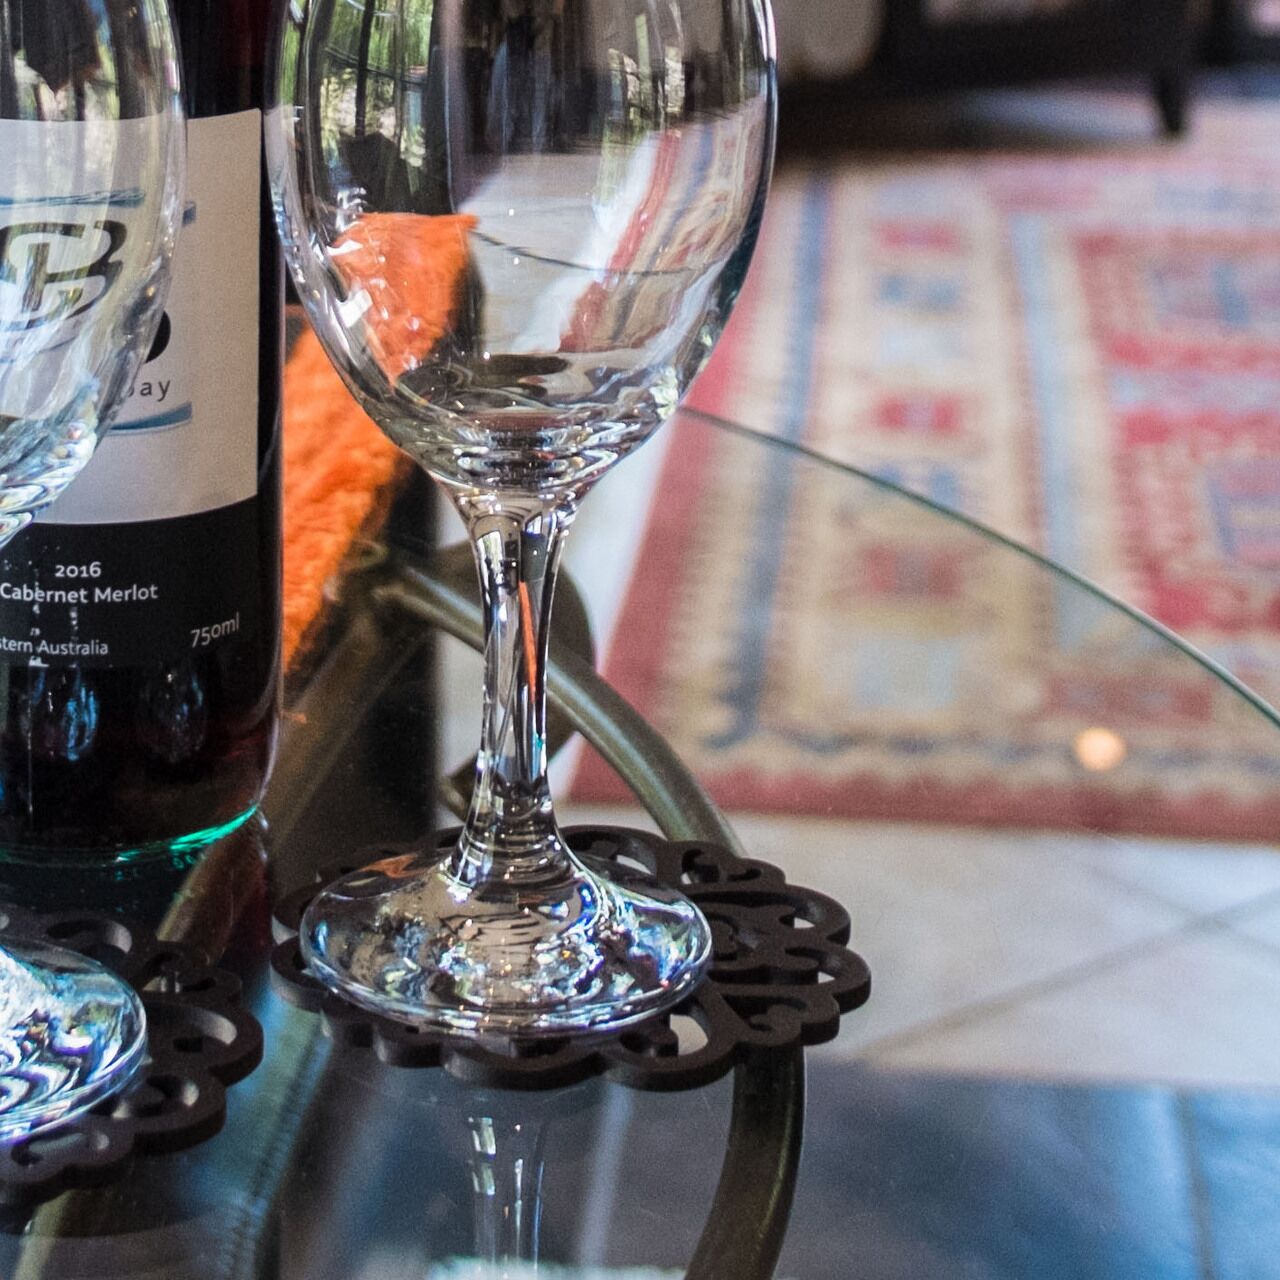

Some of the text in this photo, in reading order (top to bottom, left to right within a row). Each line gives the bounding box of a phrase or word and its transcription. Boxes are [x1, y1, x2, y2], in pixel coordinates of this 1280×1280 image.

[54, 561, 102, 578] 2016
[0, 582, 159, 604] Cabernet Merlot
[190, 612, 241, 649] 750ml
[37, 639, 110, 656] Australia
